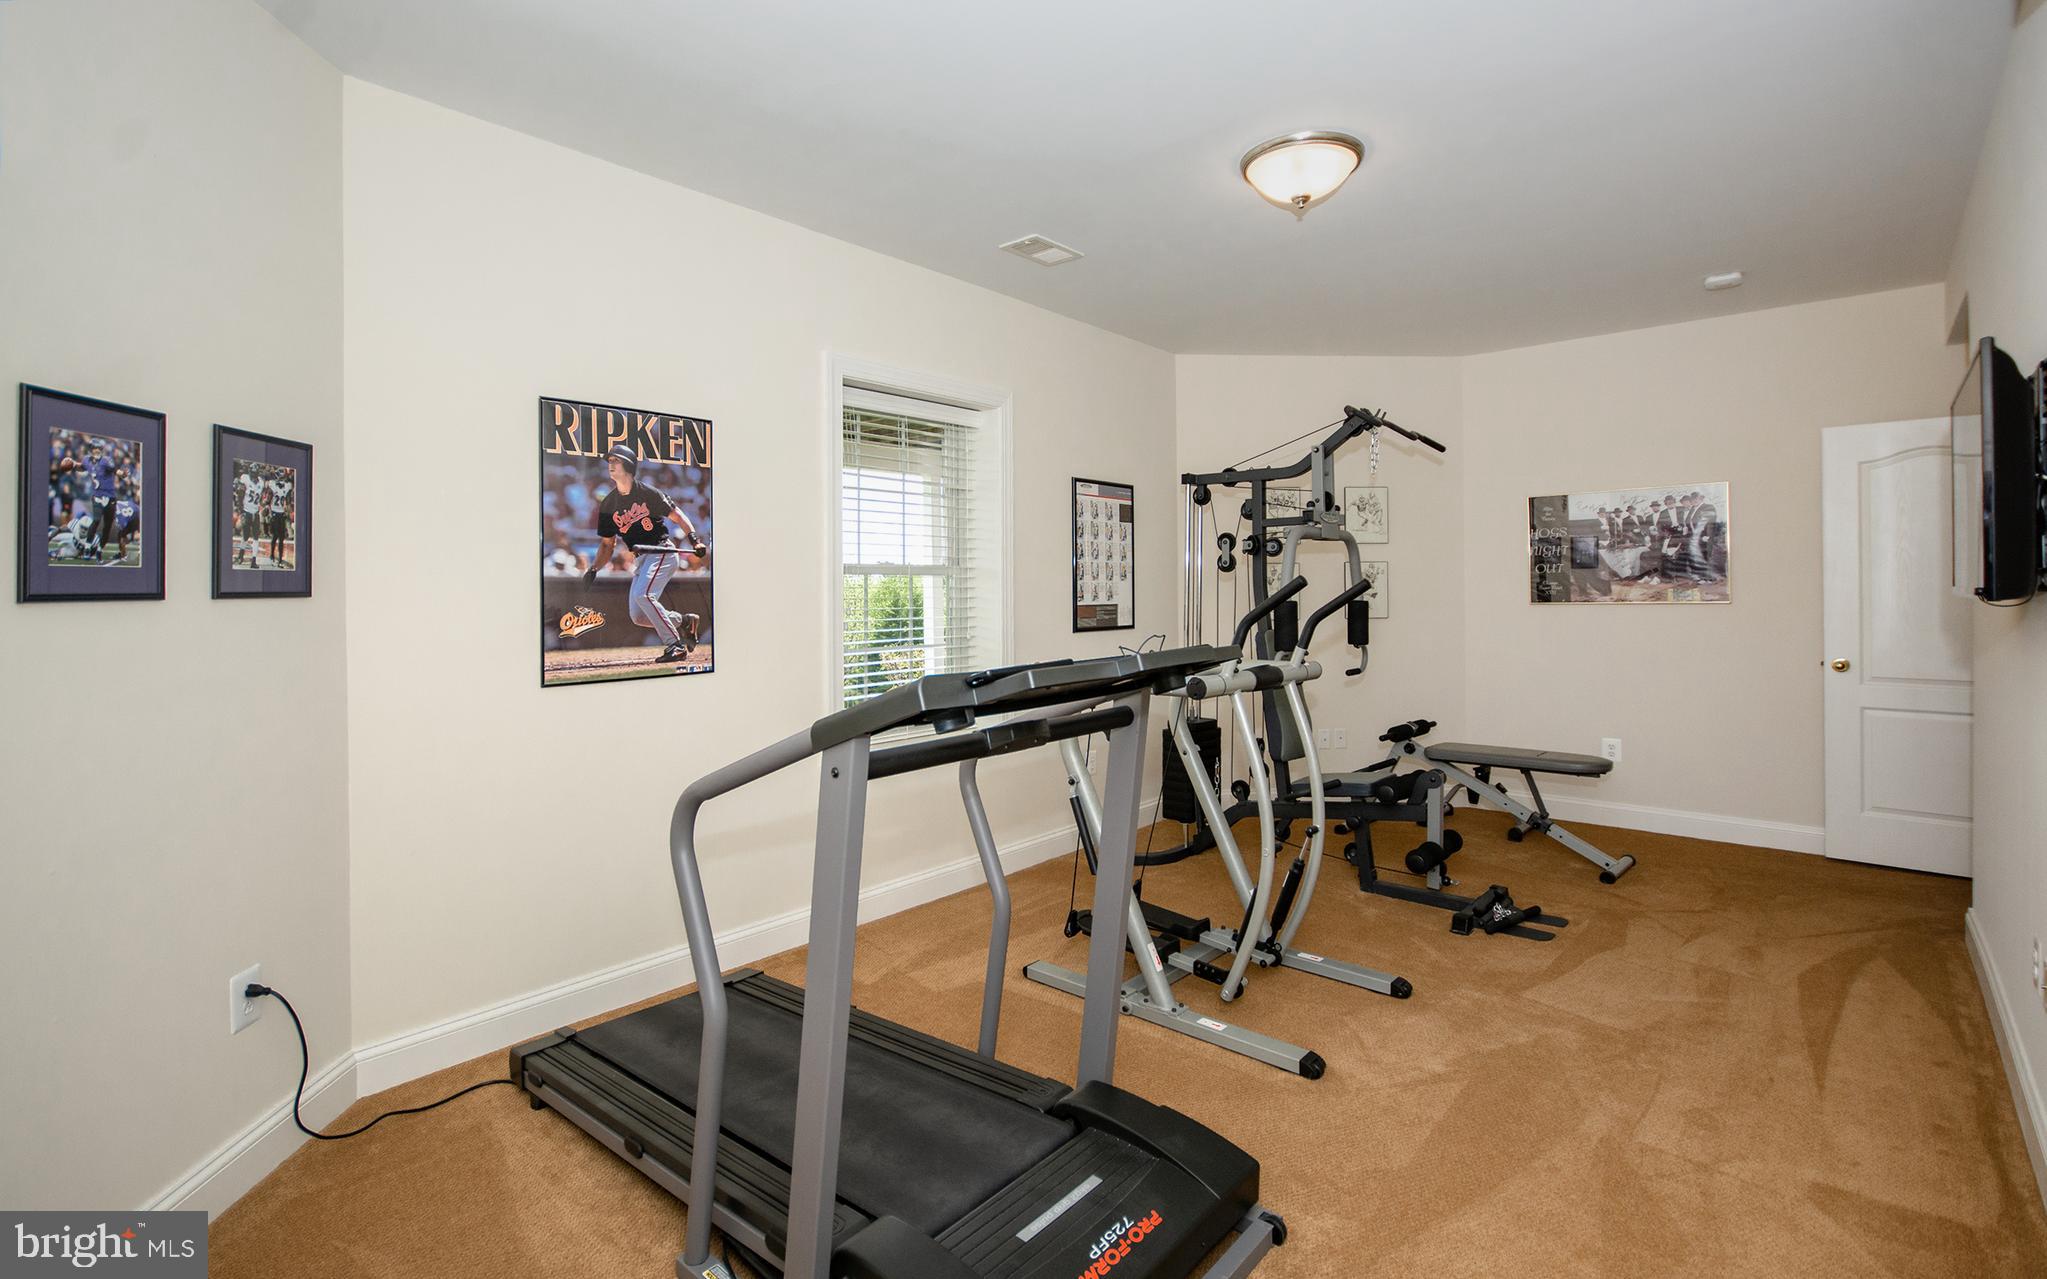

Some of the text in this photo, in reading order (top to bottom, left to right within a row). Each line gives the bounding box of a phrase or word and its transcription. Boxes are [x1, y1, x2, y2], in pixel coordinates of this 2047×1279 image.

[542, 400, 711, 467] RIPKEN
[641, 517, 654, 531] 8
[1535, 563, 1564, 574] OUT
[559, 611, 605, 633] Orioles
[1089, 1216, 1135, 1260] 725FP
